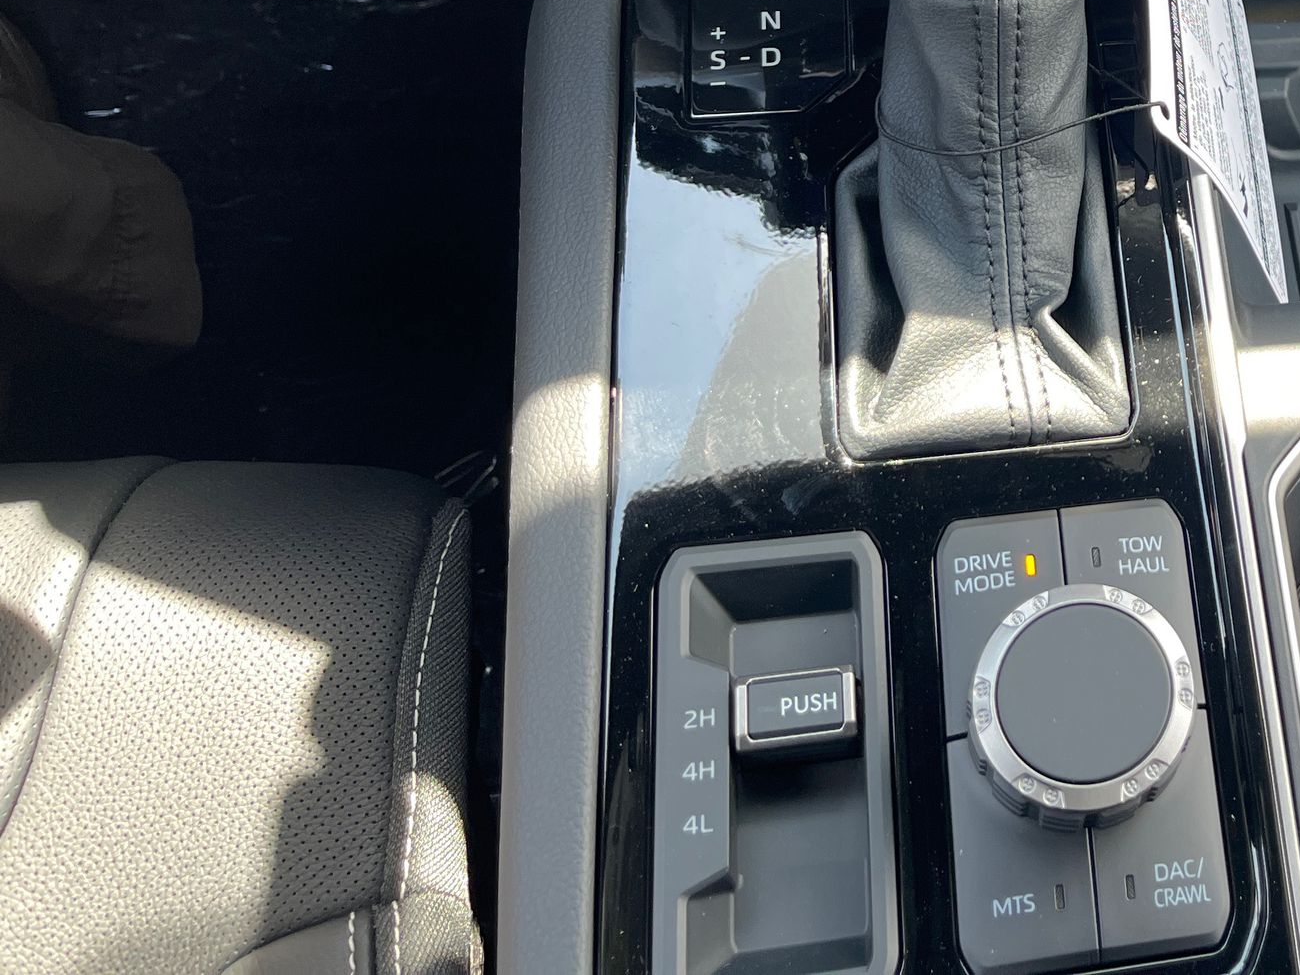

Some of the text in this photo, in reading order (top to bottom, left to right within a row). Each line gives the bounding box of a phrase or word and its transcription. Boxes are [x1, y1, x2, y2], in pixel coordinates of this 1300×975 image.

[760, 10, 781, 31] N
[710, 50, 727, 70] S
[761, 47, 781, 67] D
[1118, 535, 1163, 554] TOW
[954, 550, 1013, 574] DRIVE
[1118, 555, 1170, 575] HAUL
[954, 570, 1016, 596] MODE
[780, 691, 838, 716] PUSH
[683, 708, 716, 730] 2H
[682, 759, 716, 782] 4H
[682, 814, 715, 835] 4L
[1154, 856, 1205, 882] DAC/
[992, 893, 1037, 918] MTS
[1154, 882, 1213, 908] CRAWL
